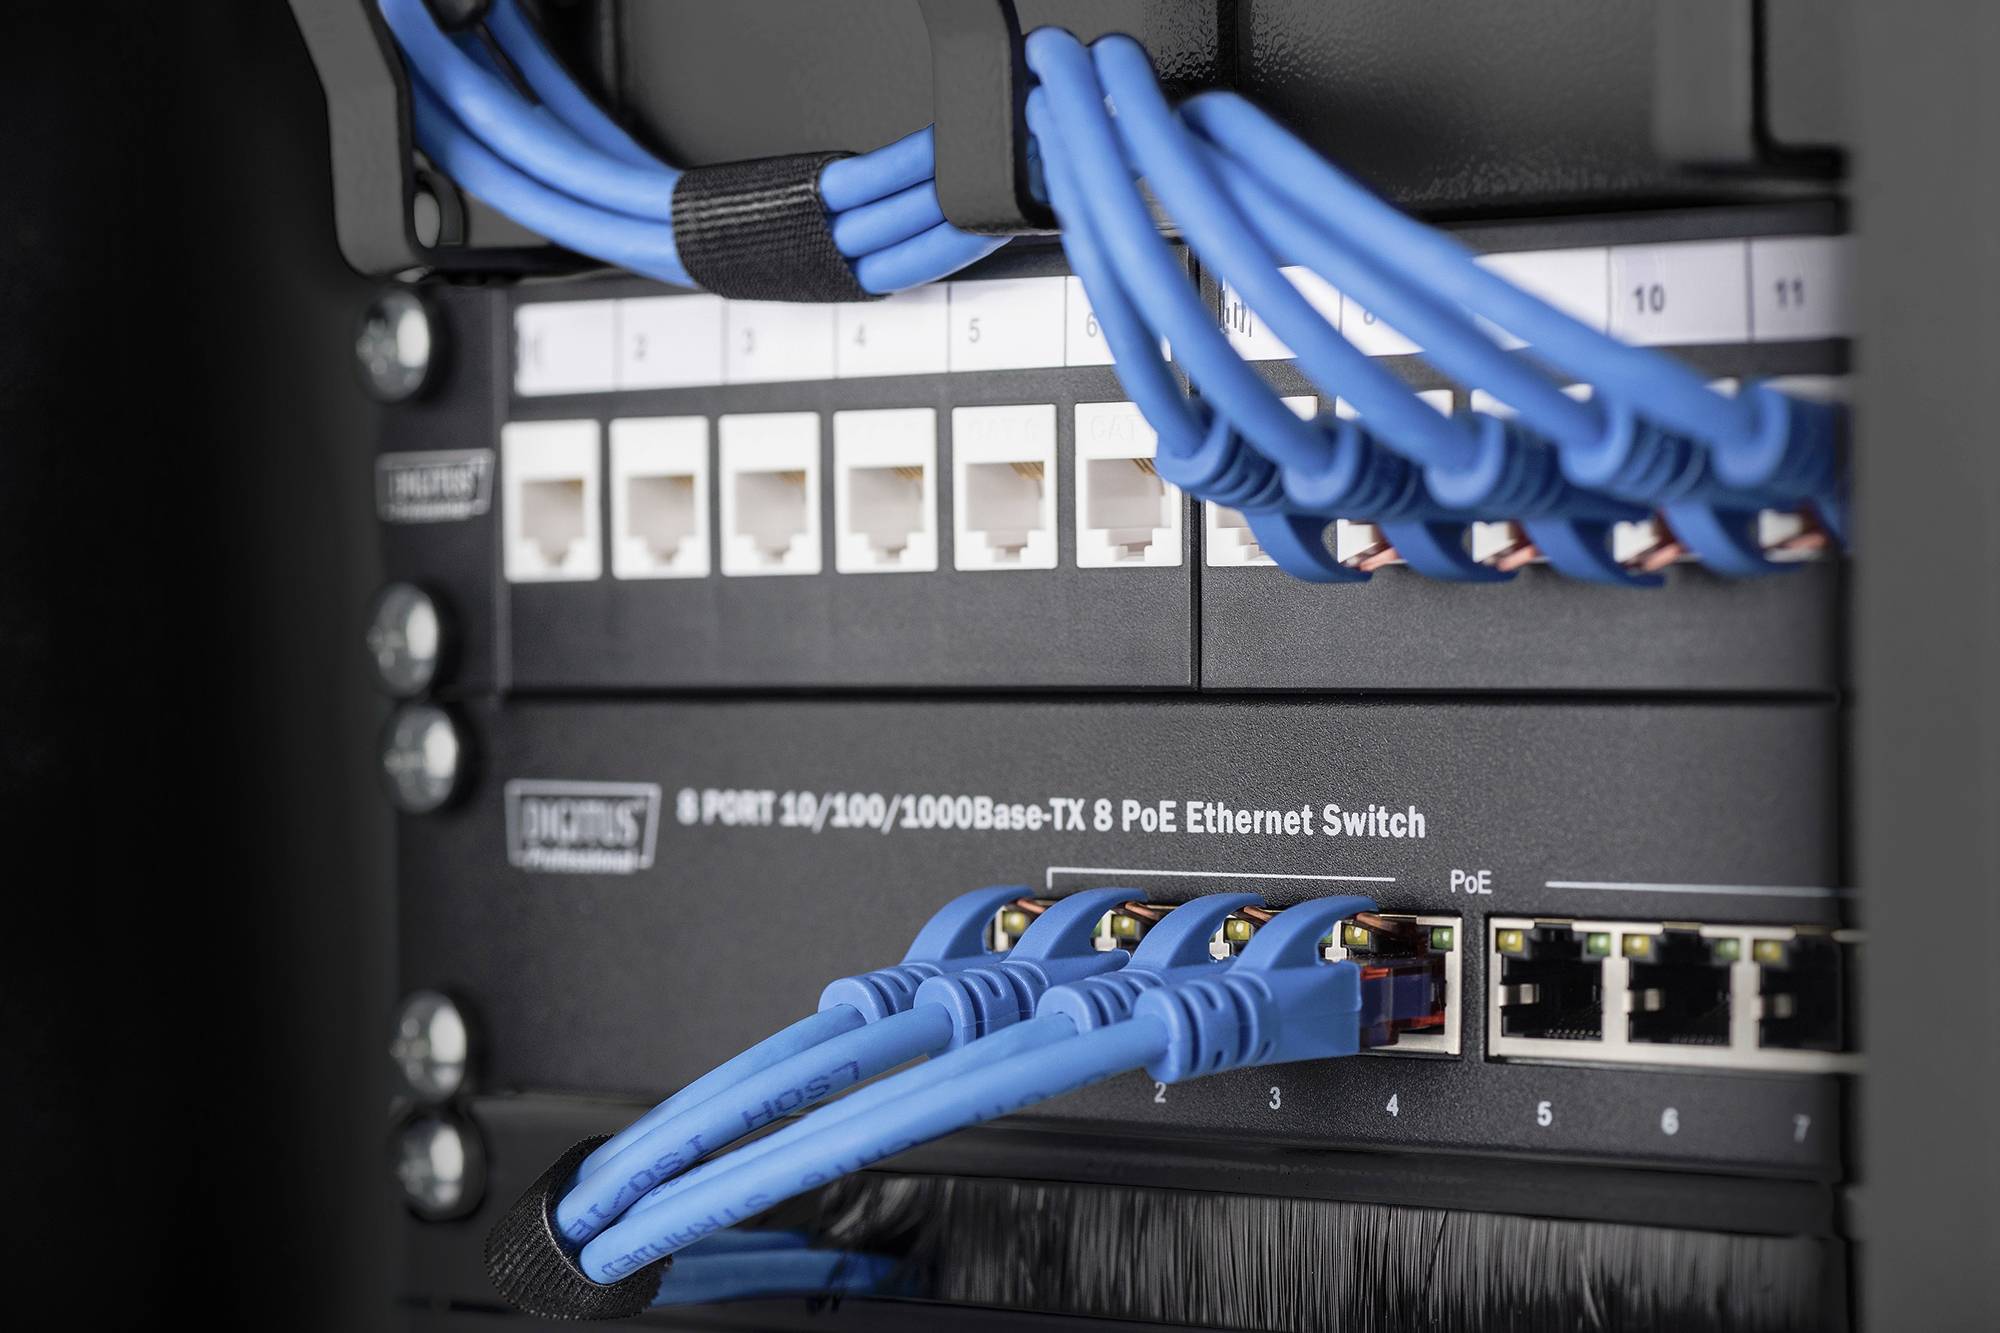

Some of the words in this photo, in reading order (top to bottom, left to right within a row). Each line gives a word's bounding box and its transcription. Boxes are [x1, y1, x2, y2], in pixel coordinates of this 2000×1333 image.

[1633, 284, 1665, 314] 10
[1774, 277, 1805, 309] 11
[853, 325, 867, 349] 4
[968, 318, 981, 343] 5
[1086, 312, 1098, 338] 6
[676, 788, 699, 825] 8
[703, 789, 776, 826] PORT
[779, 790, 1087, 835] 10/100/1000Base-TX
[1093, 797, 1114, 832] 8
[1122, 798, 1178, 834] PoE
[1186, 800, 1315, 836] Ethernet
[1322, 804, 1426, 839] Switch
[1450, 868, 1493, 896] PoE
[1154, 1082, 1169, 1104] 2
[1268, 1086, 1282, 1110] 3
[1385, 1093, 1399, 1117] 4
[1536, 1101, 1553, 1127] 5
[1660, 1107, 1680, 1136] 6
[566, 1133, 704, 1243] ISO/IE
